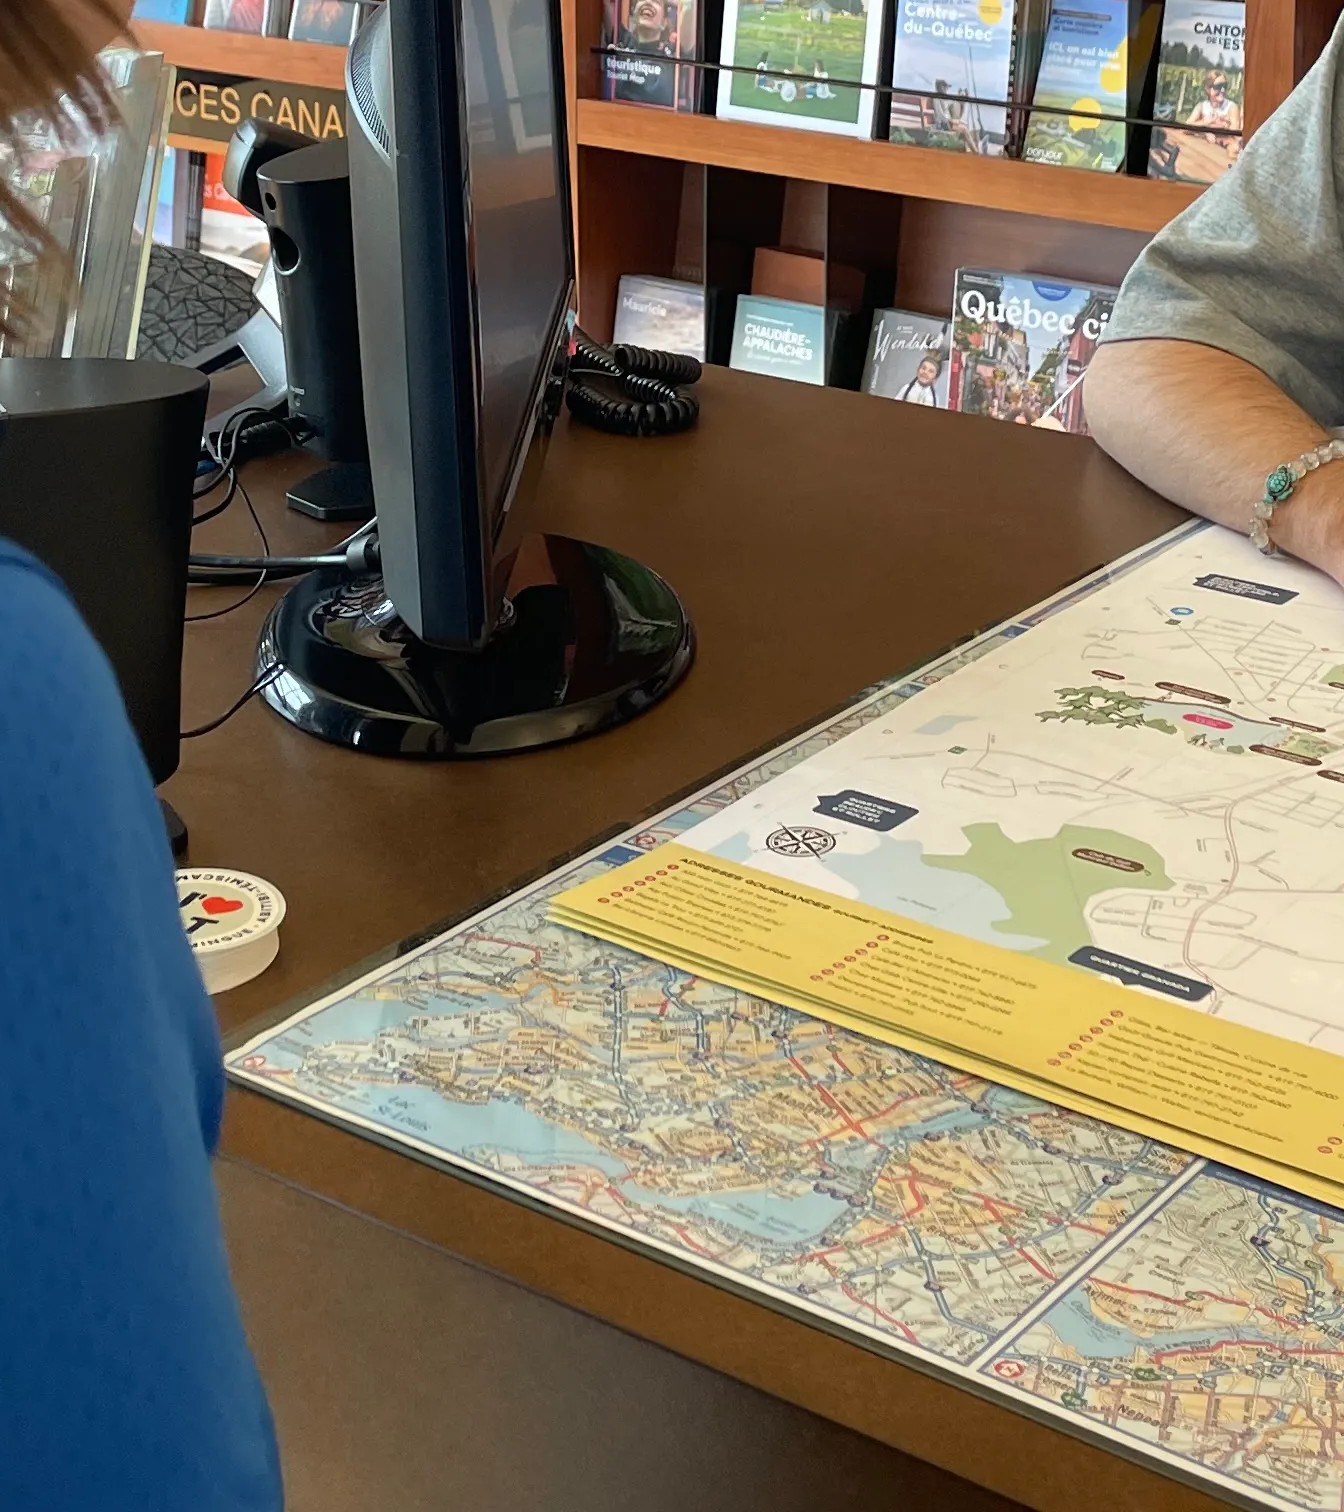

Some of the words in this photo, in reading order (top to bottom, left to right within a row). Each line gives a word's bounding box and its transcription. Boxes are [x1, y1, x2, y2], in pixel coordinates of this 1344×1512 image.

[904, 4, 966, 20] Centre-
[903, 21, 992, 42] du-Québec
[607, 57, 661, 76] touristique
[176, 81, 241, 124] CES
[622, 296, 668, 318] Mauricie
[960, 289, 1076, 331] Québec
[743, 321, 811, 346] CHAUDIÈRE-
[742, 336, 813, 361] APPALACHES
[679, 857, 743, 880] ADRESSES
[744, 878, 831, 909] GOURMANDES
[1089, 954, 1140, 976] QUARTIER
